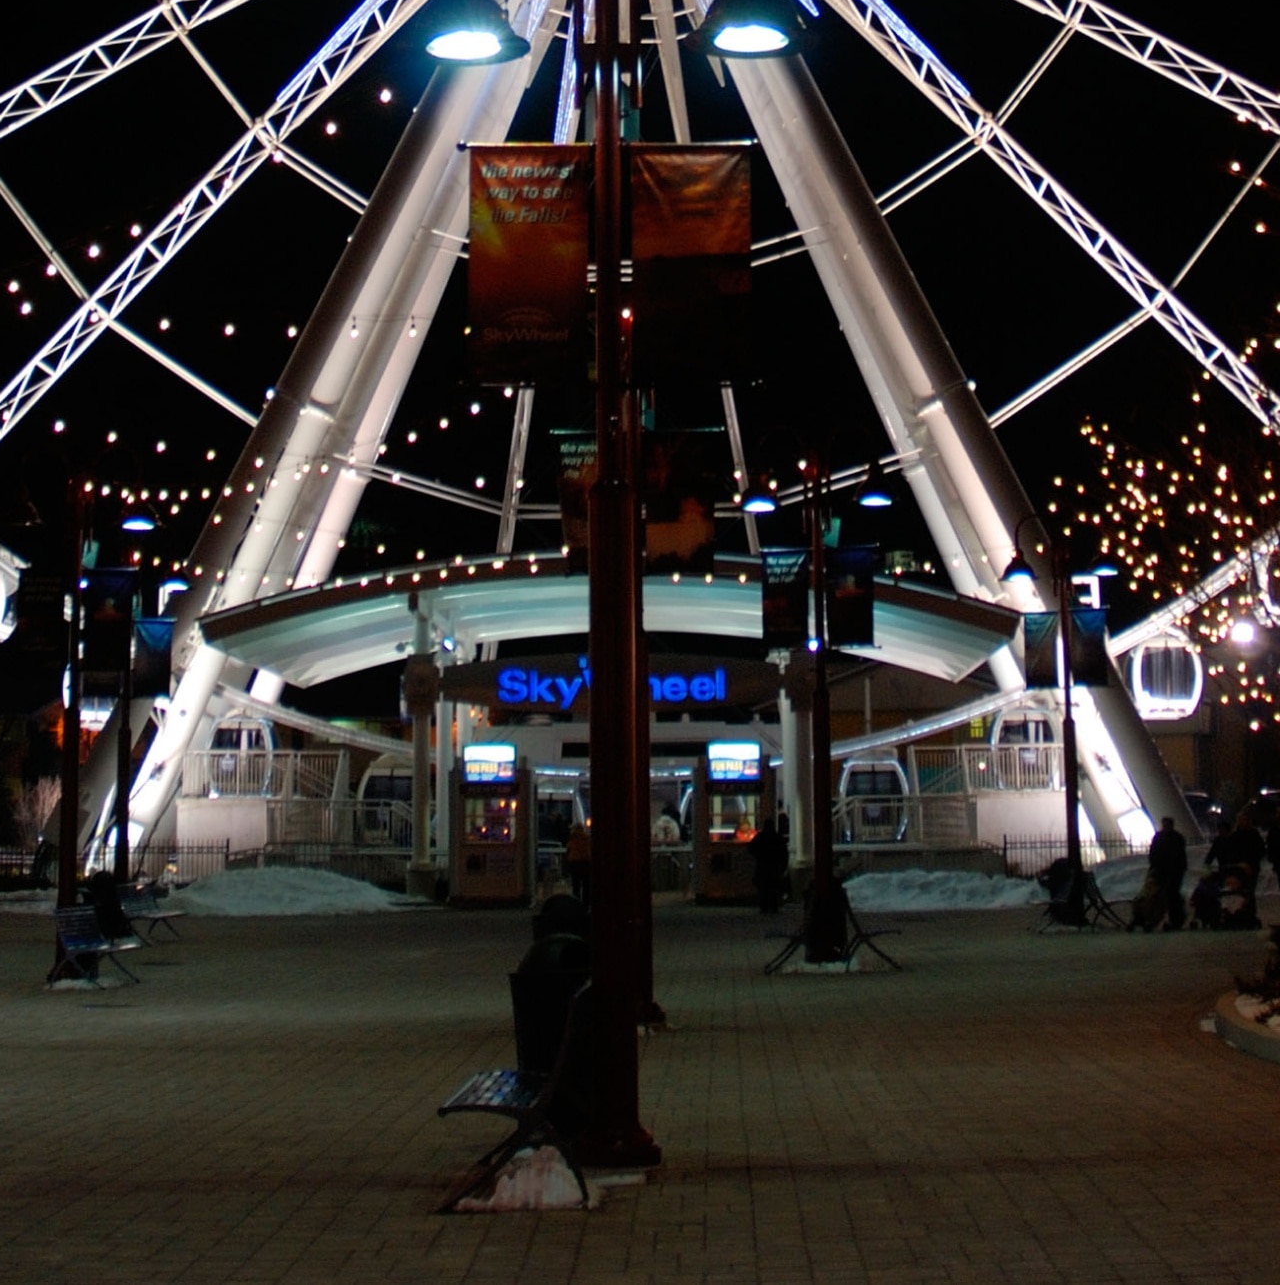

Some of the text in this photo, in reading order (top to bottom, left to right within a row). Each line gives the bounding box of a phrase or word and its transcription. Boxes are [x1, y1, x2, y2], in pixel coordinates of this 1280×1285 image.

[481, 163, 508, 179] the
[487, 186, 520, 203] way
[522, 183, 539, 199] to
